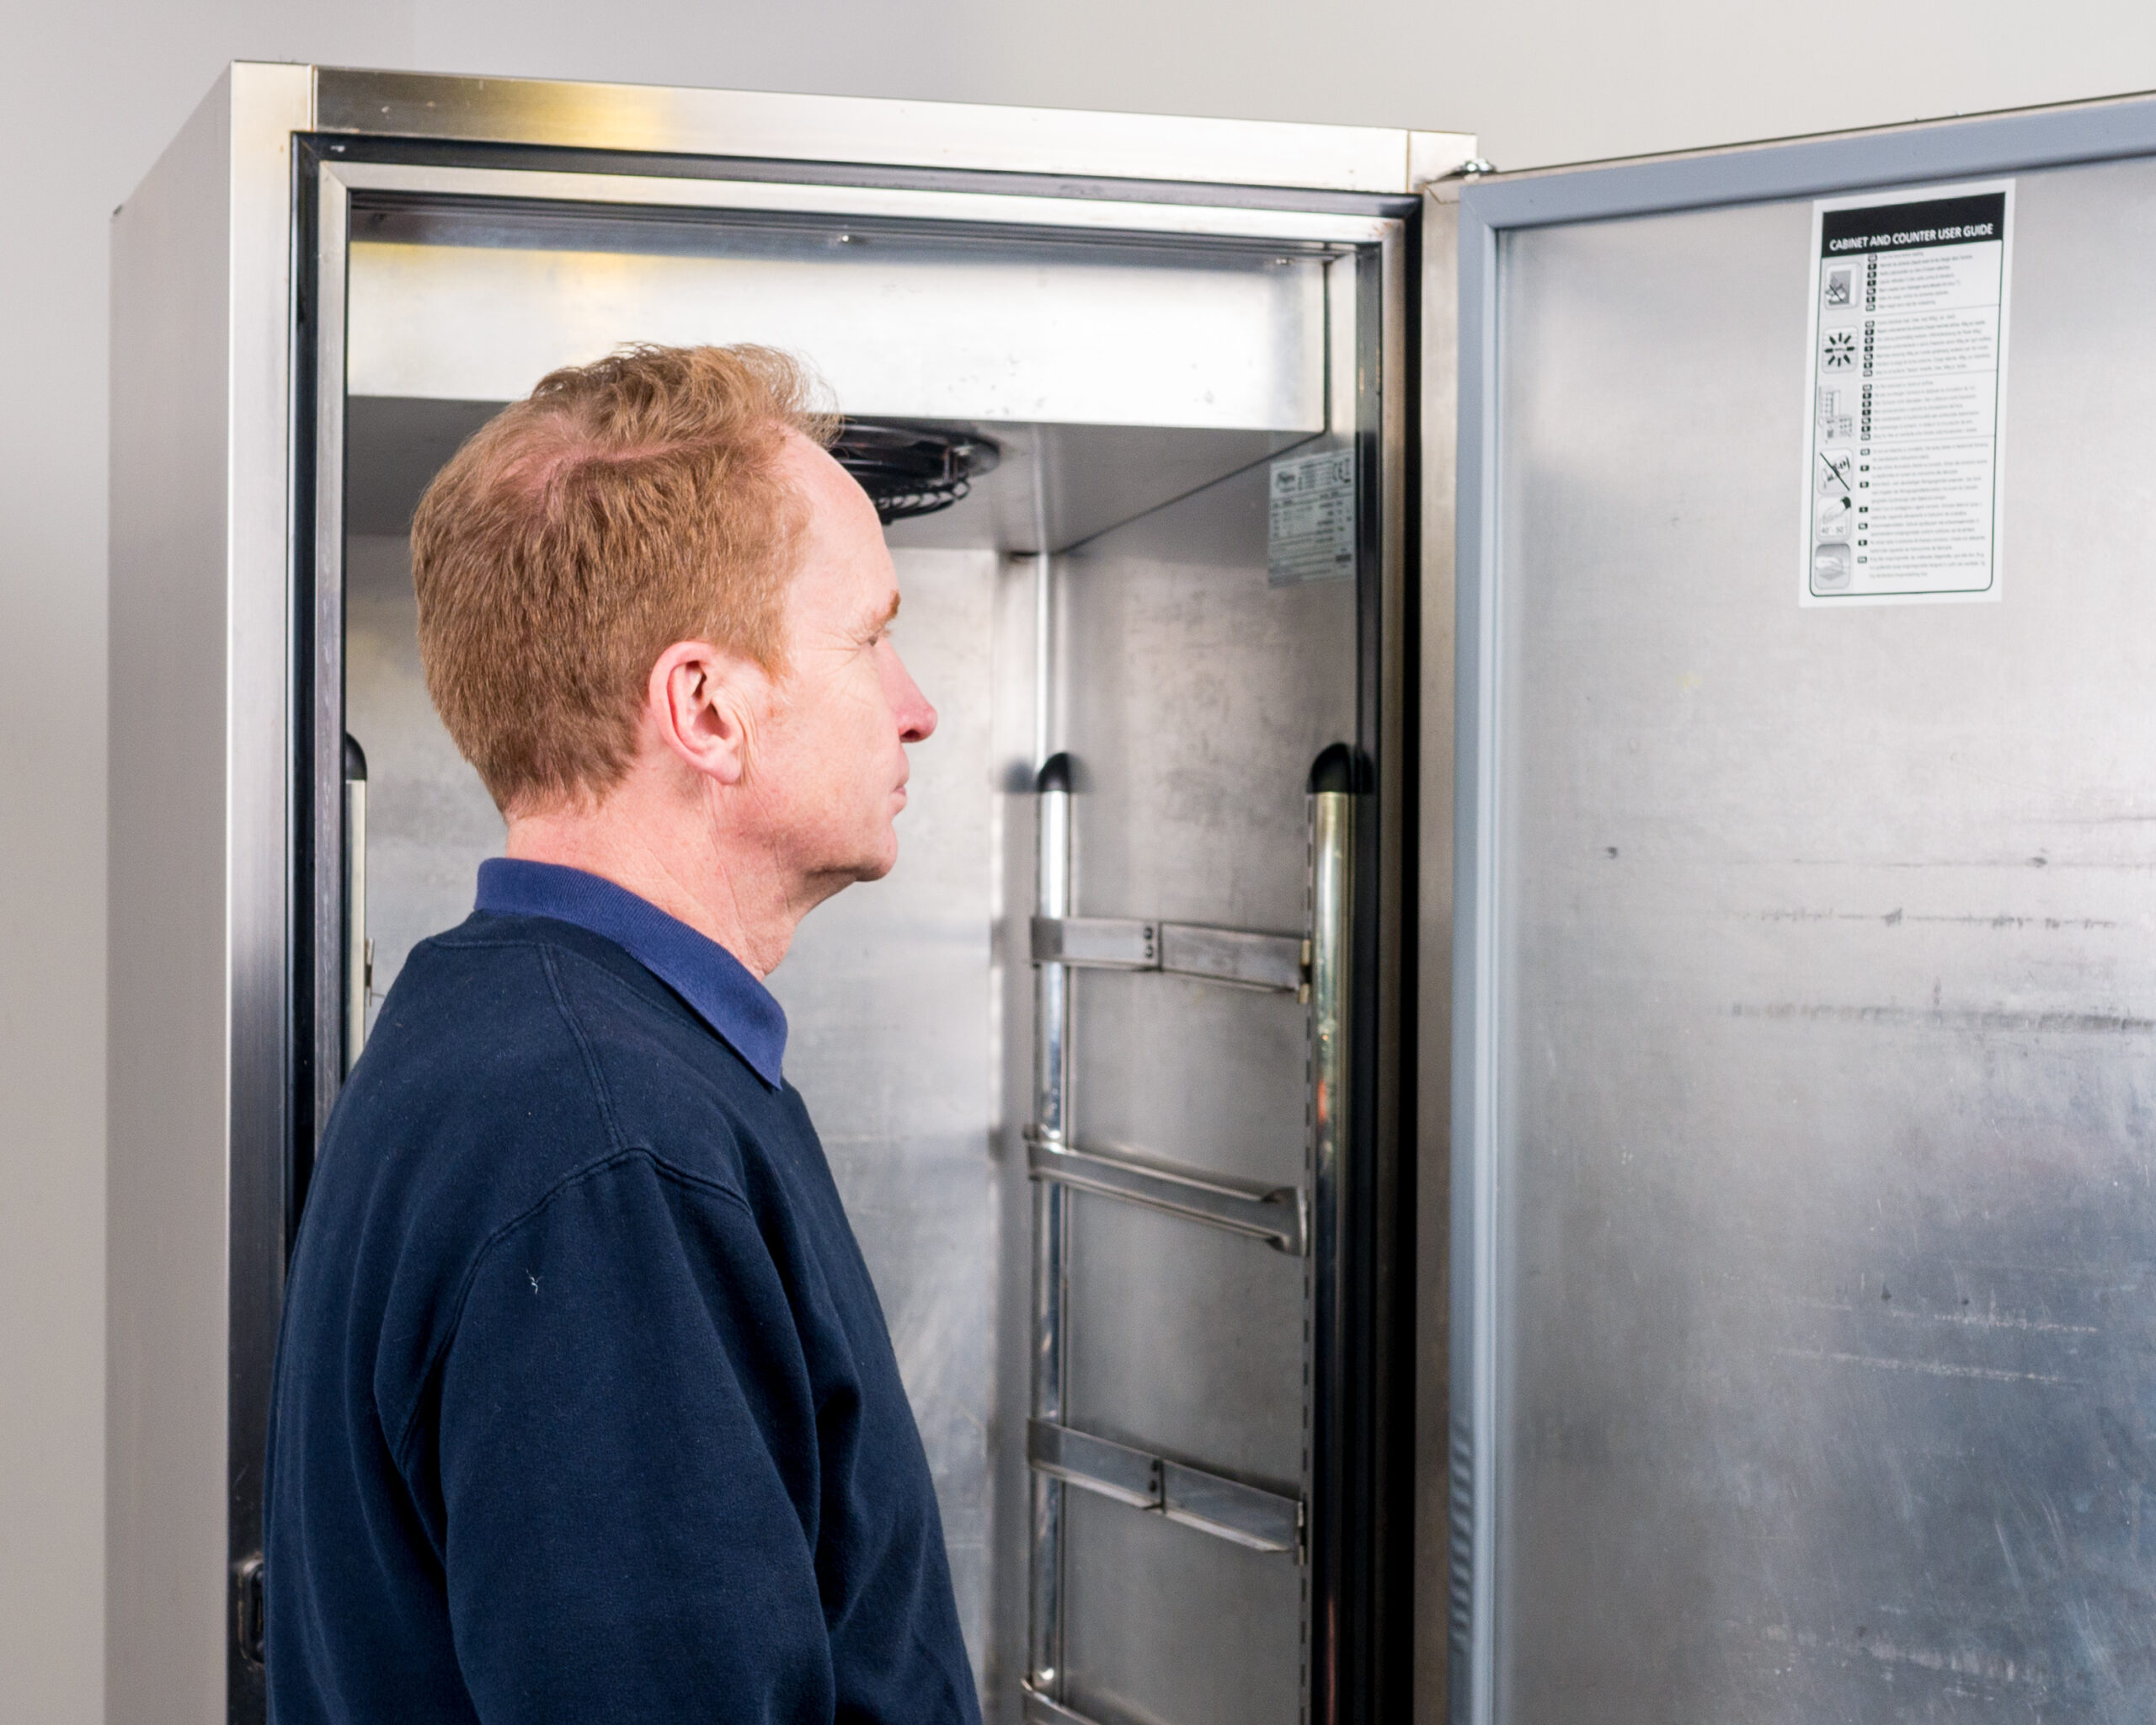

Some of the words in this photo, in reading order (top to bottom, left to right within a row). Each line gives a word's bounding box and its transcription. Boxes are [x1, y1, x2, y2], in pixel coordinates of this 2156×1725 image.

[1829, 236, 1869, 251] CABINET
[1870, 234, 1892, 248] AND
[1892, 229, 1936, 245] COUNTER
[1938, 227, 1961, 240] USER
[1963, 223, 1993, 238] GUIDE
